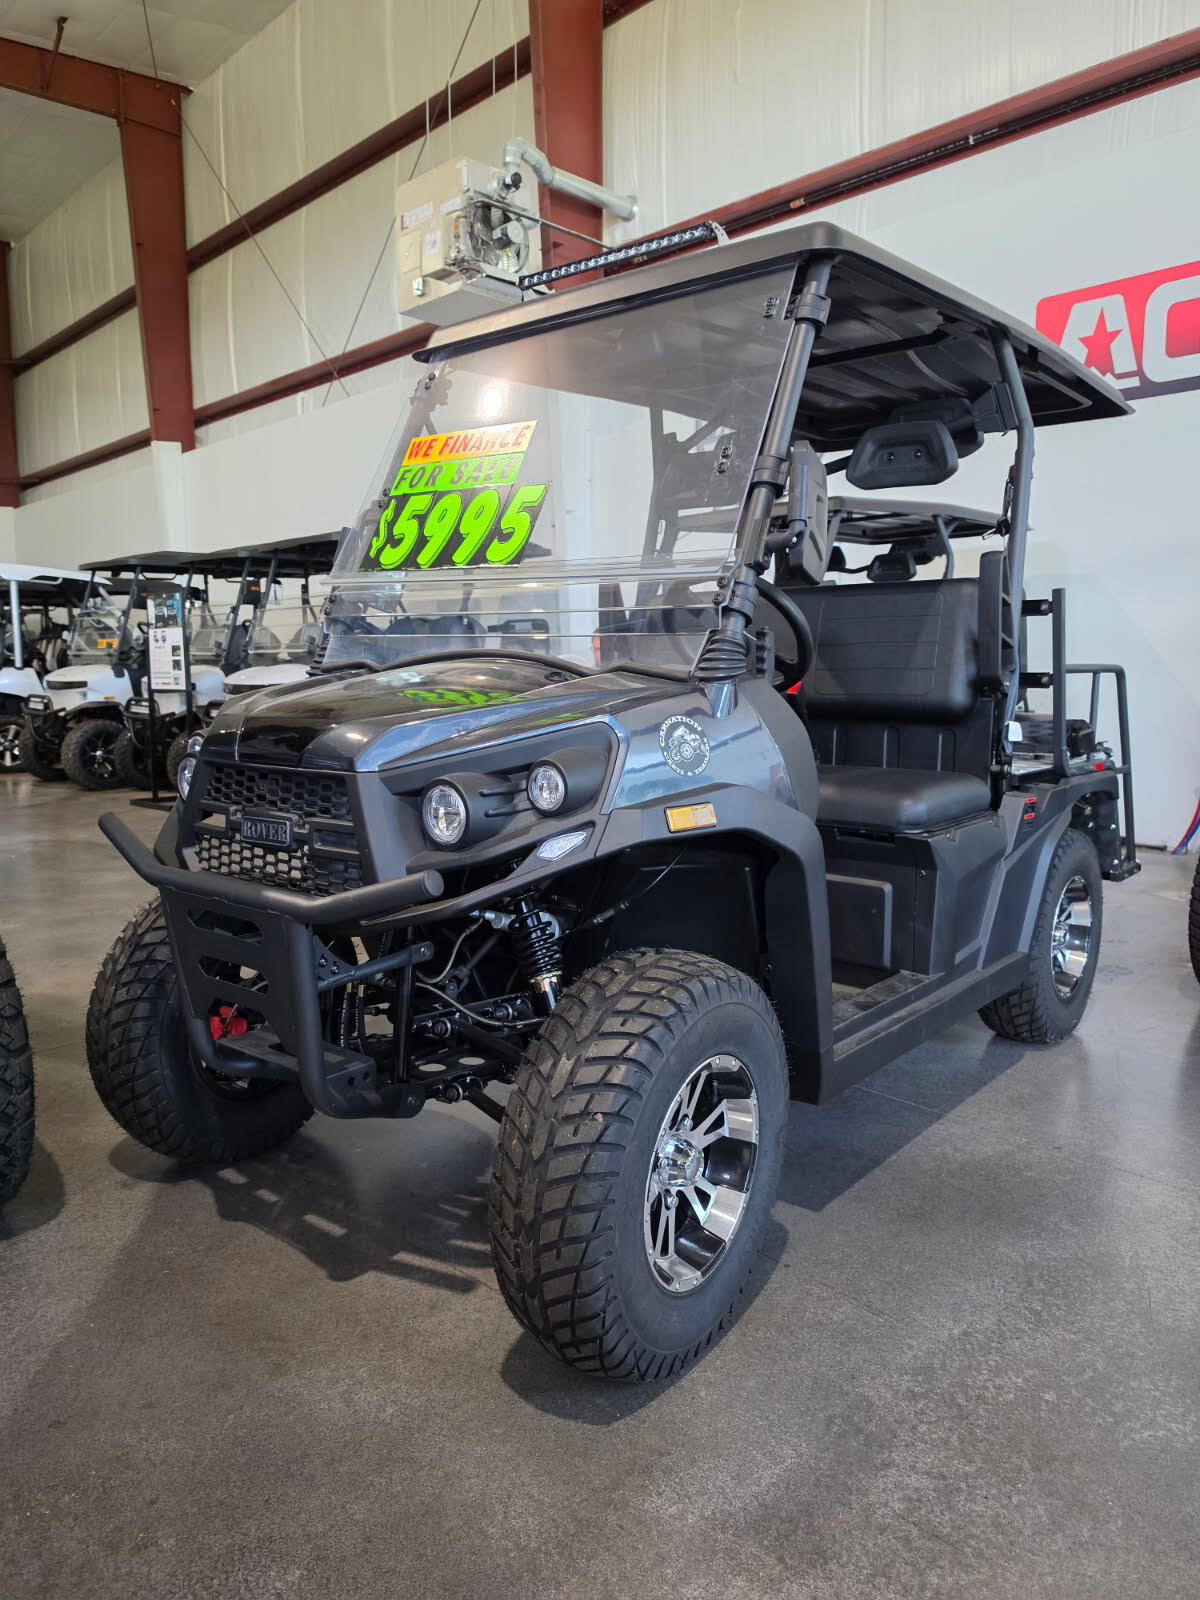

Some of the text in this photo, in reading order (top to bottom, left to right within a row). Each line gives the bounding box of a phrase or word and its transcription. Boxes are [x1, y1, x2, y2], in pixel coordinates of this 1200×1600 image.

[407, 425, 531, 461] WE FINANCE
[394, 456, 515, 490] FOR SALE
[370, 484, 546, 569] $5995
[660, 715, 702, 747] CARNATION
[243, 821, 287, 841] ROVER
